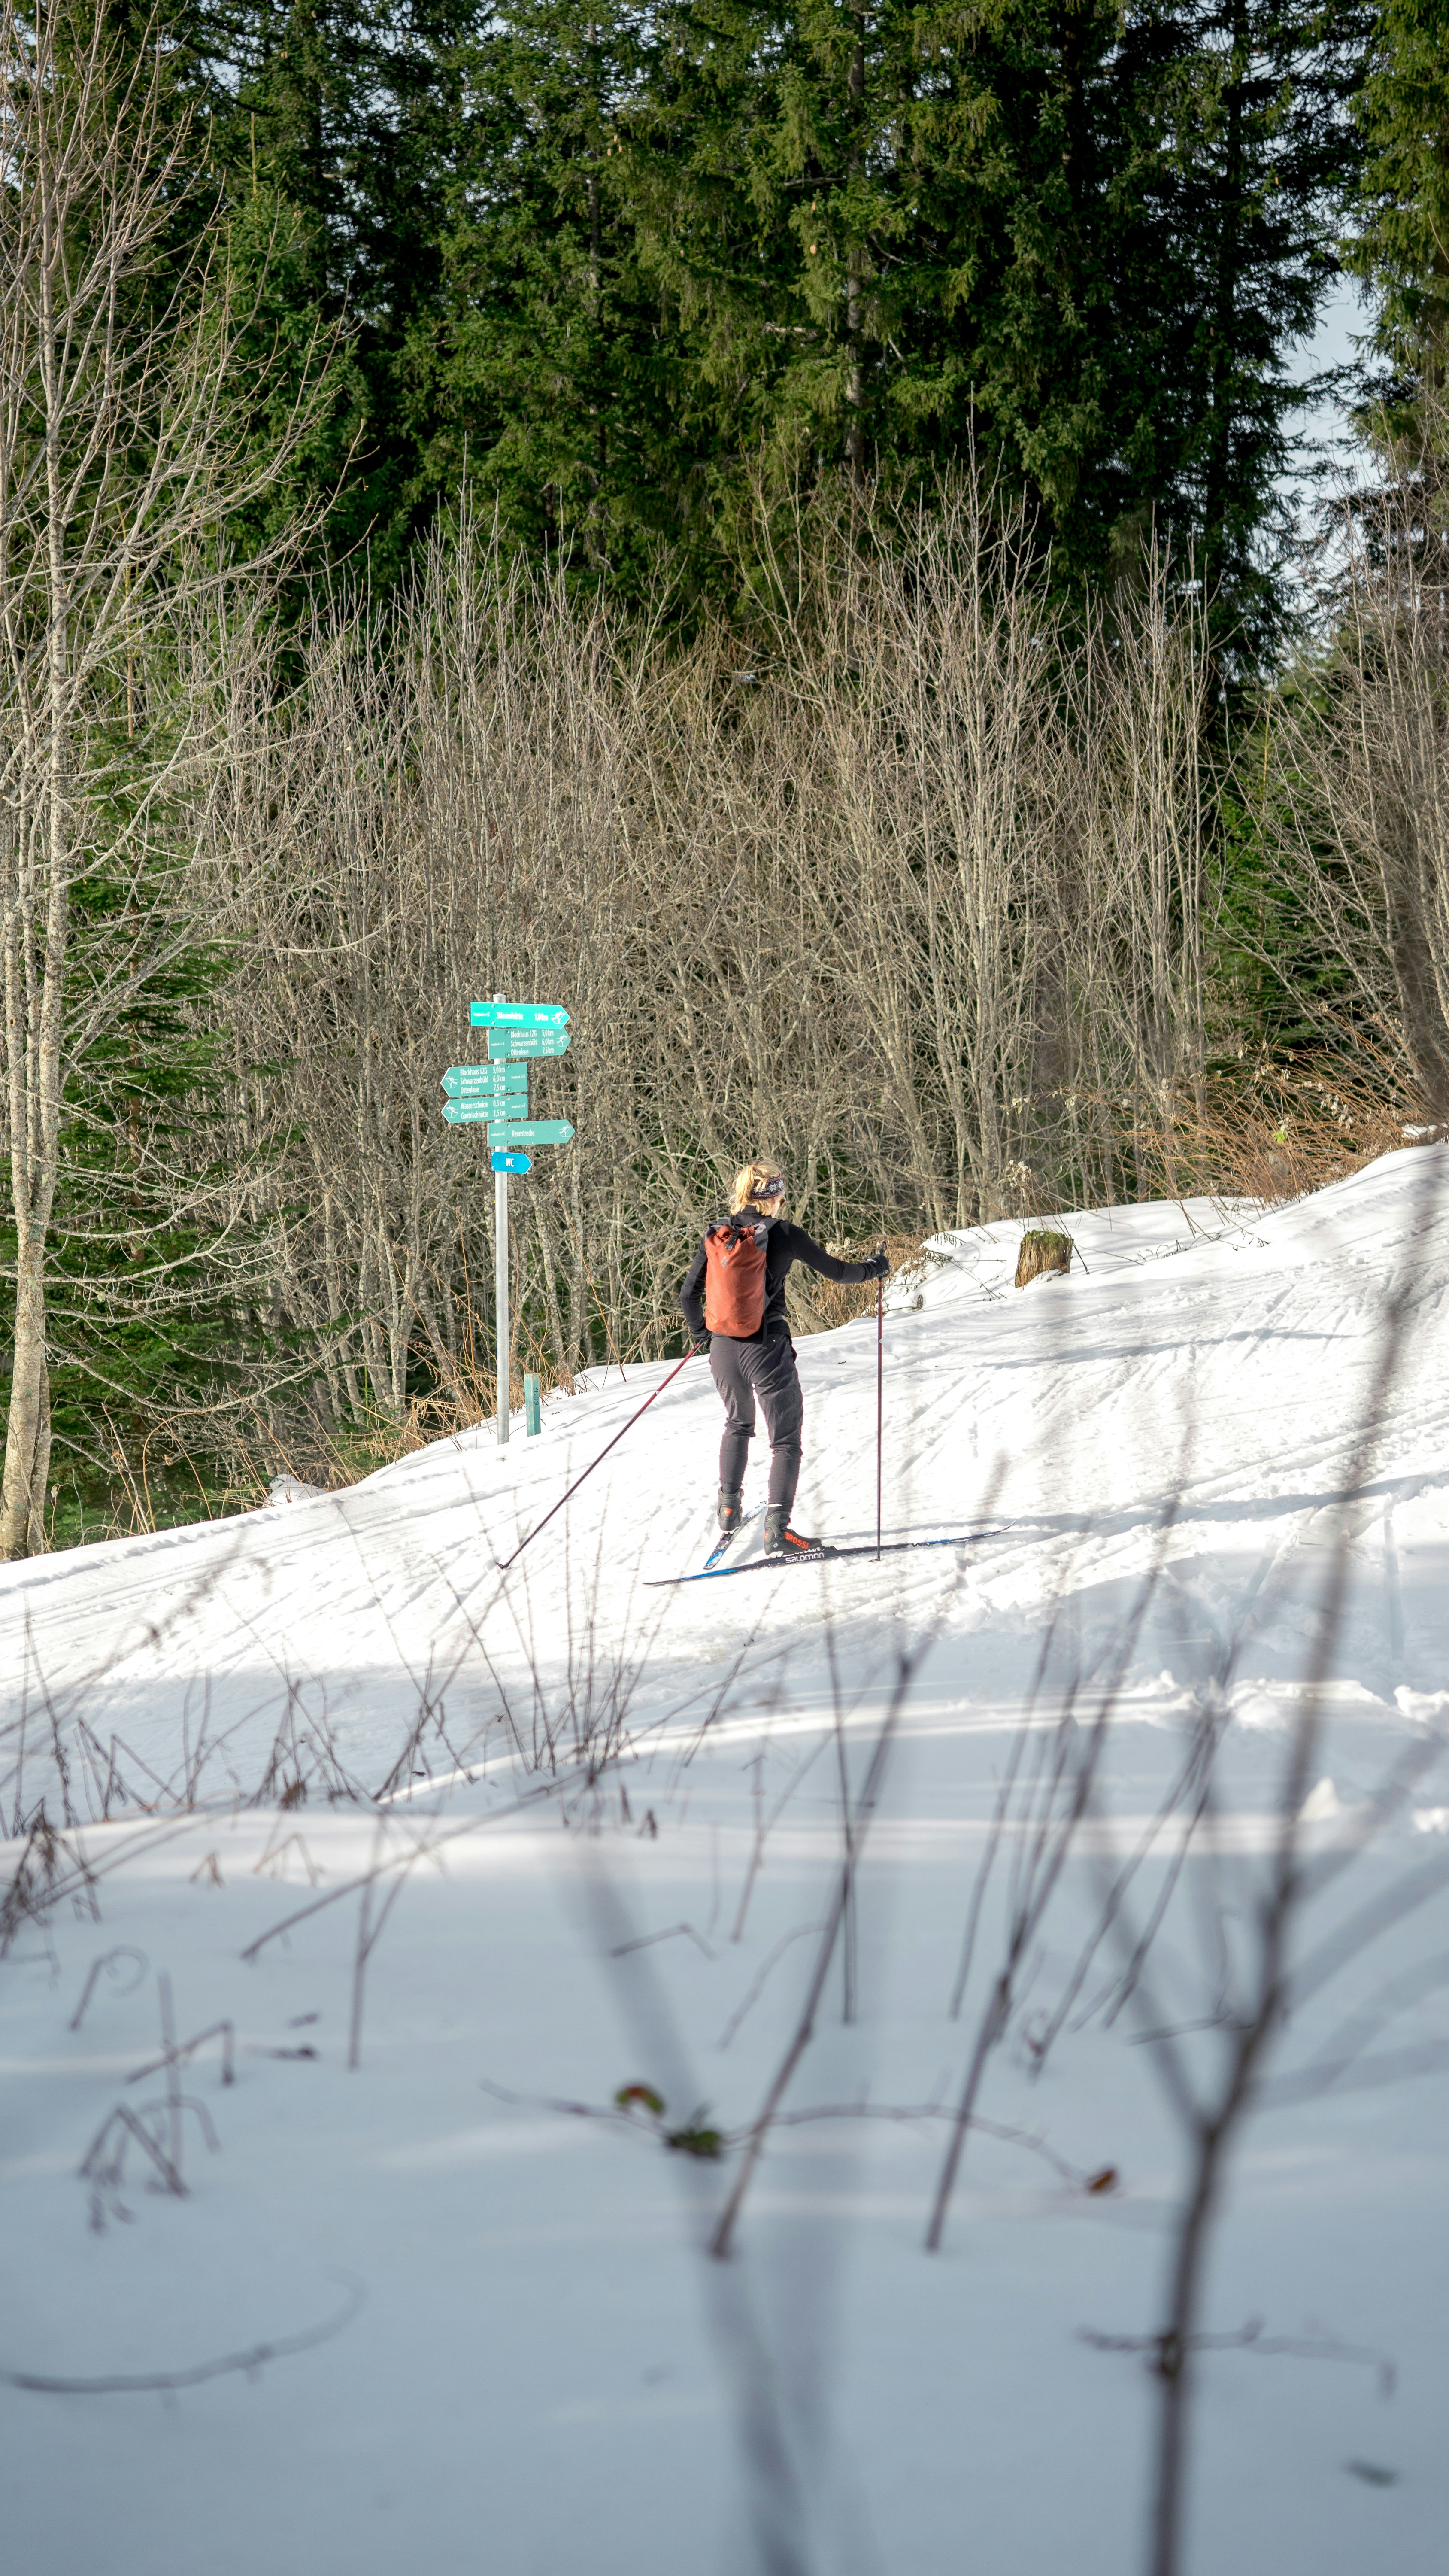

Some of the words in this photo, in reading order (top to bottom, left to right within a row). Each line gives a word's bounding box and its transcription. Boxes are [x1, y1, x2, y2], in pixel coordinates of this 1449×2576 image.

[497, 1012, 523, 1020] Stierenhütte
[541, 1013, 549, 1021] km
[511, 1039, 538, 1047] Schwarzenbühl
[460, 1076, 488, 1085] Schwarzenbühl
[461, 1101, 488, 1109] Wasserscheide
[461, 1111, 488, 1119] Gantrischhütte
[512, 1129, 535, 1137] Rennstrecke
[505, 1157, 514, 1167] WC
